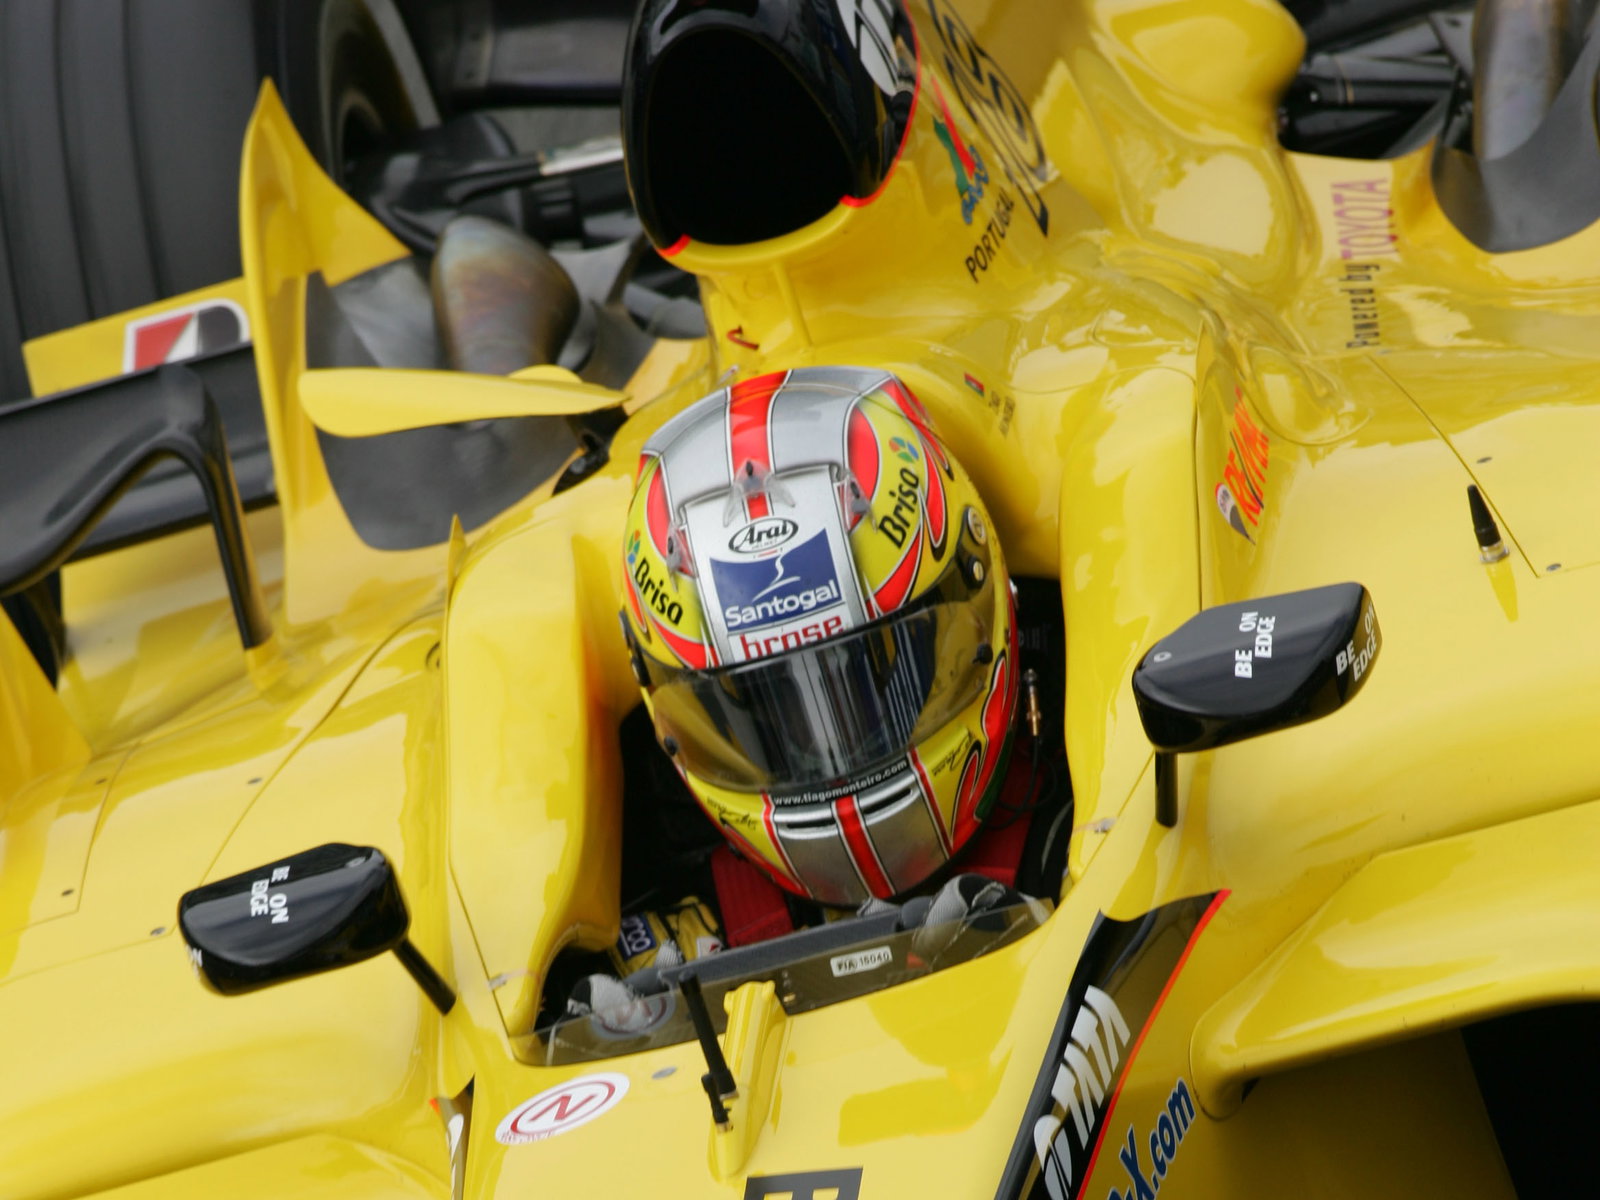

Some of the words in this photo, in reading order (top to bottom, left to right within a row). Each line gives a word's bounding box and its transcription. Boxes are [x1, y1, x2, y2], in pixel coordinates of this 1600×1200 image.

[965, 190, 1014, 283] PORTUGAL
[1331, 179, 1398, 260] TOYOTA
[735, 519, 790, 550] Arai
[725, 579, 840, 627] Santogal
[1239, 611, 1259, 632] ON
[740, 616, 845, 661] brose
[1255, 616, 1276, 658] EDGE
[1336, 639, 1355, 676] BE
[1352, 629, 1377, 682] EDGE
[1235, 649, 1253, 678] BE
[773, 759, 908, 806] www.tiagomonteiro.com
[250, 878, 270, 917] EDGE
[269, 893, 289, 924] ON
[1051, 985, 1131, 1151] TATA
